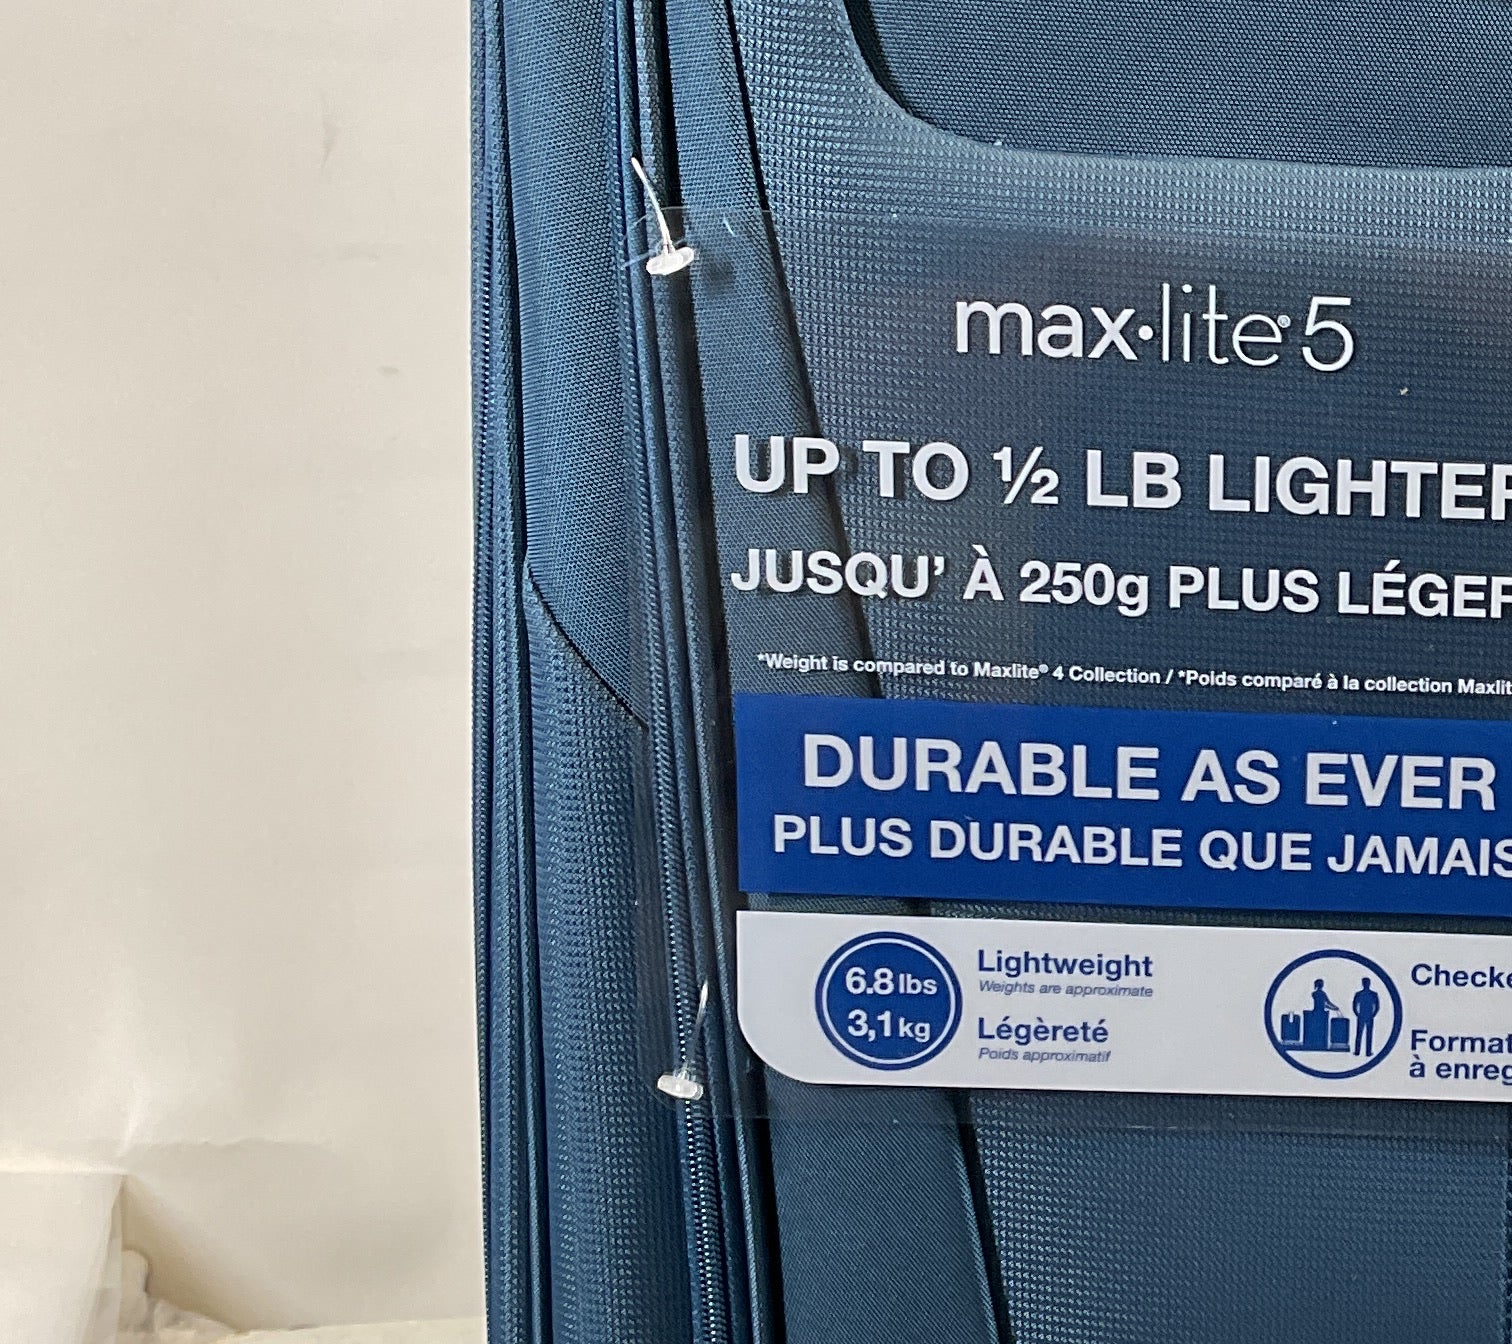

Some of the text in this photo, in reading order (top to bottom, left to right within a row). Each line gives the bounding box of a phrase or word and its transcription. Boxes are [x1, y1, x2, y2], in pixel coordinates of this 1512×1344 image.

[734, 435, 839, 493] UP
[863, 440, 968, 500] TO
[1087, 450, 1181, 508] LB
[963, 544, 1004, 600] À
[1020, 561, 1148, 616] 250g
[1170, 566, 1318, 612] PLUS
[832, 656, 848, 670] is
[854, 660, 945, 676] compared
[950, 662, 968, 675] to
[1053, 666, 1064, 679] 4
[1069, 666, 1160, 683] Collection
[1242, 673, 1322, 691] comparé
[1328, 674, 1338, 689] à
[1344, 675, 1359, 689] la
[1365, 677, 1452, 692] collection
[805, 734, 1495, 810] DURABLE AS EVER
[775, 815, 911, 856] PLUS
[931, 821, 1181, 866] DURABLE
[1201, 831, 1311, 870] QUE
[846, 968, 936, 994] 6.8 lbs
[979, 950, 1152, 981] Lightweight
[979, 980, 1153, 997] Weights are approximate
[849, 1010, 929, 1042] 3,1 kg
[979, 1016, 1108, 1045] Légèreté
[978, 1047, 1111, 1063] Poids approximatif
[1410, 1054, 1425, 1077] à
